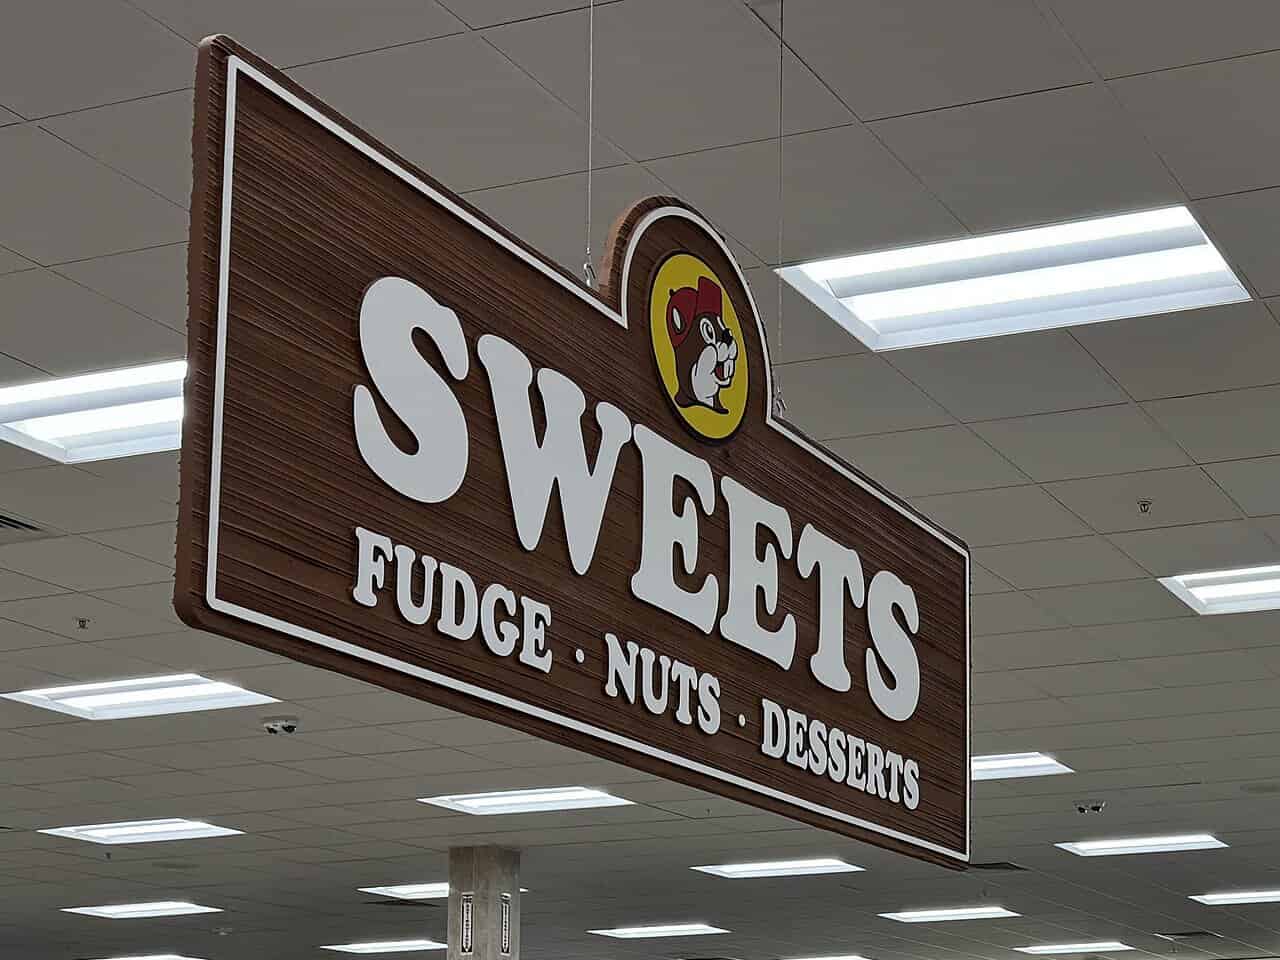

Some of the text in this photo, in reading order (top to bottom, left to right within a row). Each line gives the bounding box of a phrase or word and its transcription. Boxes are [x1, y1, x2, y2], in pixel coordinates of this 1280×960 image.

[353, 526, 920, 811] FUDGE NUTS DESSERTS
[354, 276, 920, 721] SWEETS
